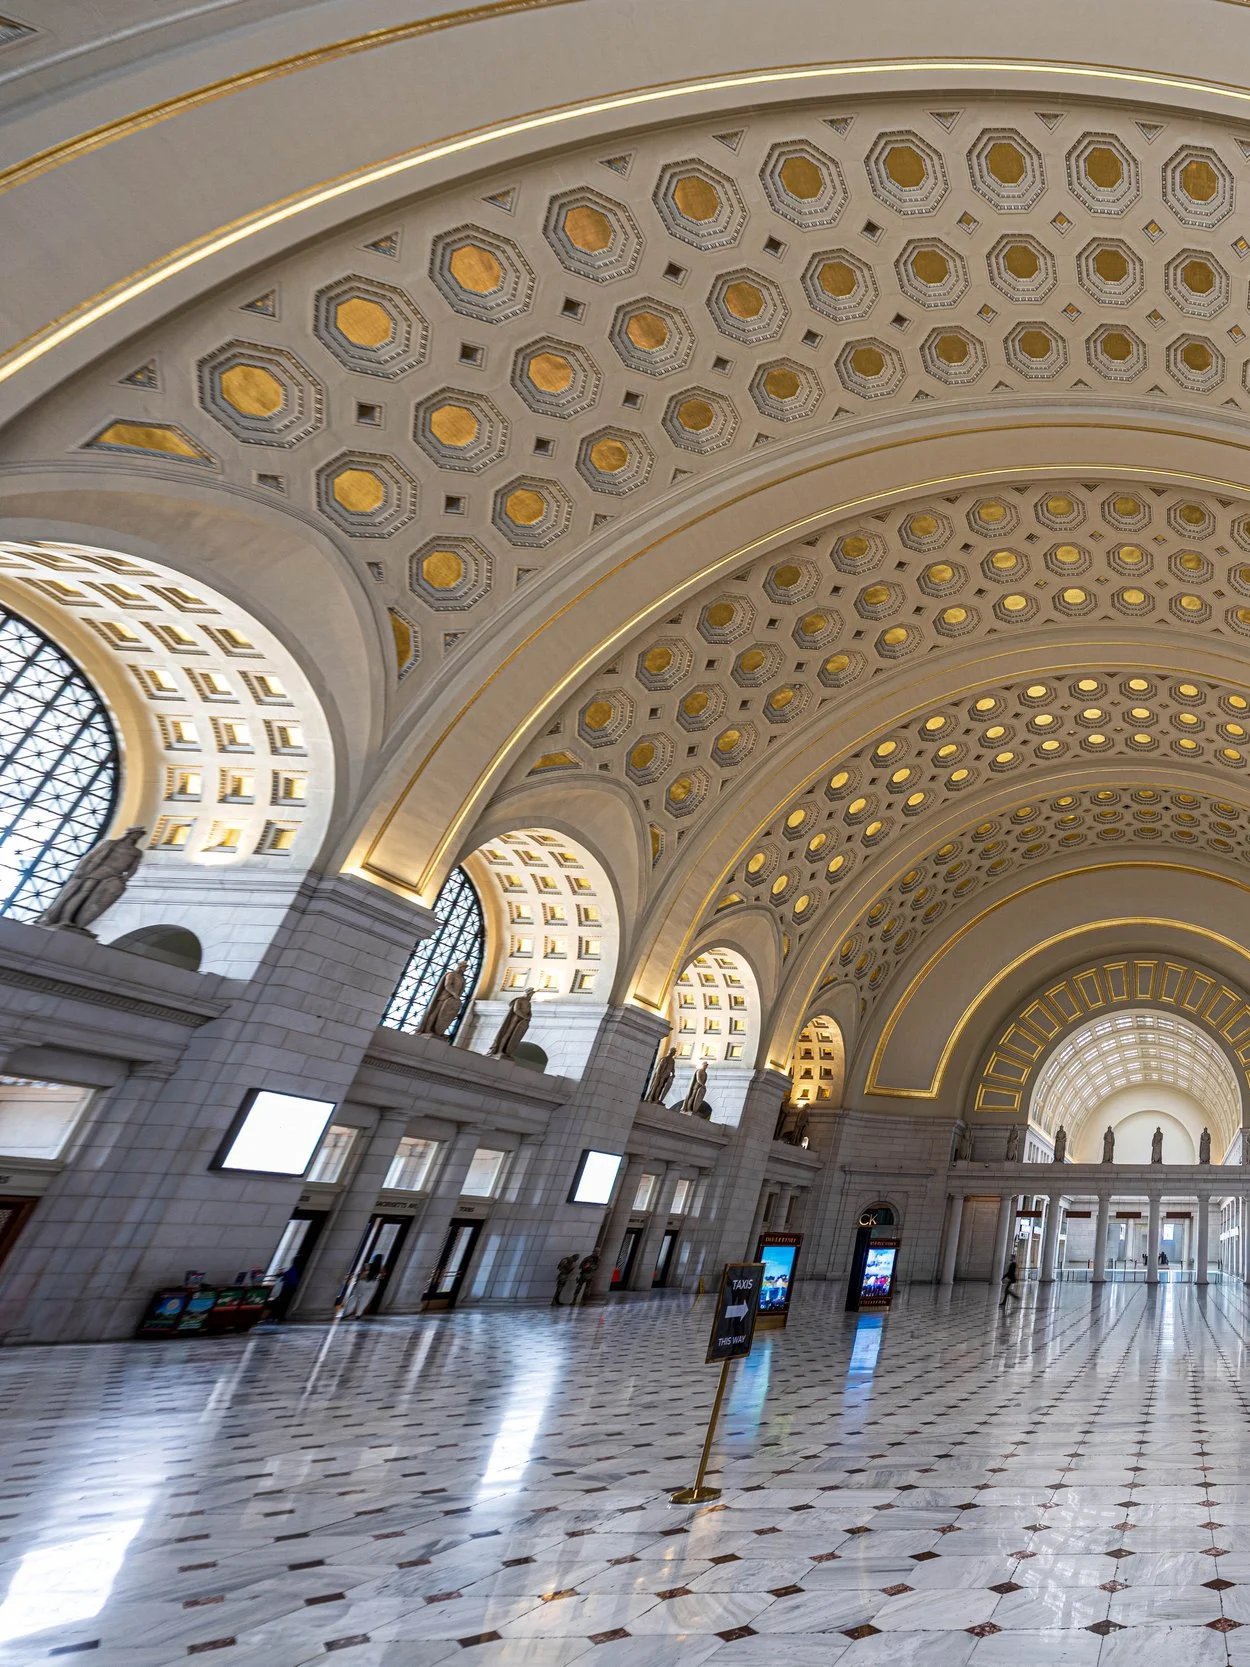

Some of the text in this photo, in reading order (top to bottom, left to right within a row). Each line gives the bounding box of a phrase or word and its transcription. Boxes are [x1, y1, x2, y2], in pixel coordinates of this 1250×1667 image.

[732, 1279, 754, 1290] TAXIS
[718, 1334, 746, 1346] THIS WAY
